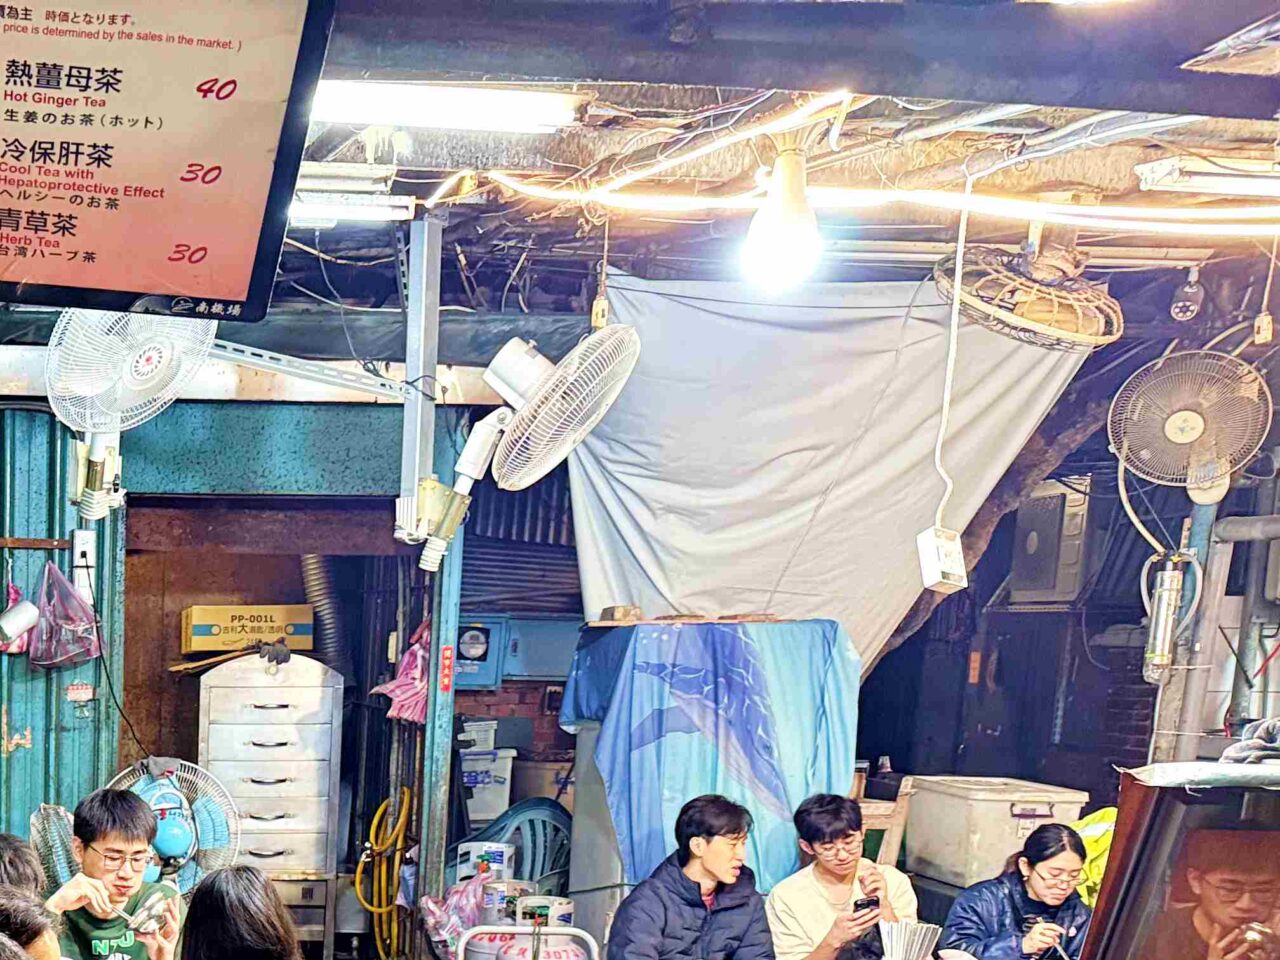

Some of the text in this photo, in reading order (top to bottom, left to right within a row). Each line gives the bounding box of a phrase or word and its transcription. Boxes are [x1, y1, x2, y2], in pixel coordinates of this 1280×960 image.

[3, 22, 28, 33] price
[31, 24, 39, 34] is
[42, 25, 100, 40] determined
[102, 30, 115, 42] by
[118, 30, 133, 40] the
[136, 32, 163, 42] sales
[166, 33, 174, 43] in
[178, 35, 193, 45] the
[5, 59, 123, 94] 熱薑母茶
[3, 90, 106, 108] Hot Ginger Tea
[196, 78, 237, 100] 40
[0, 138, 115, 168] 冷保肝茶
[35, 165, 60, 177] Tea
[64, 168, 94, 180] with
[180, 163, 222, 185] 30
[0, 189, 120, 210] ヘルシーのお茶
[123, 186, 165, 198] Effect
[0, 233, 60, 248] Herb Tea
[168, 243, 208, 264] 30
[195, 301, 242, 316] 南機場
[231, 615, 276, 623] PP-001L
